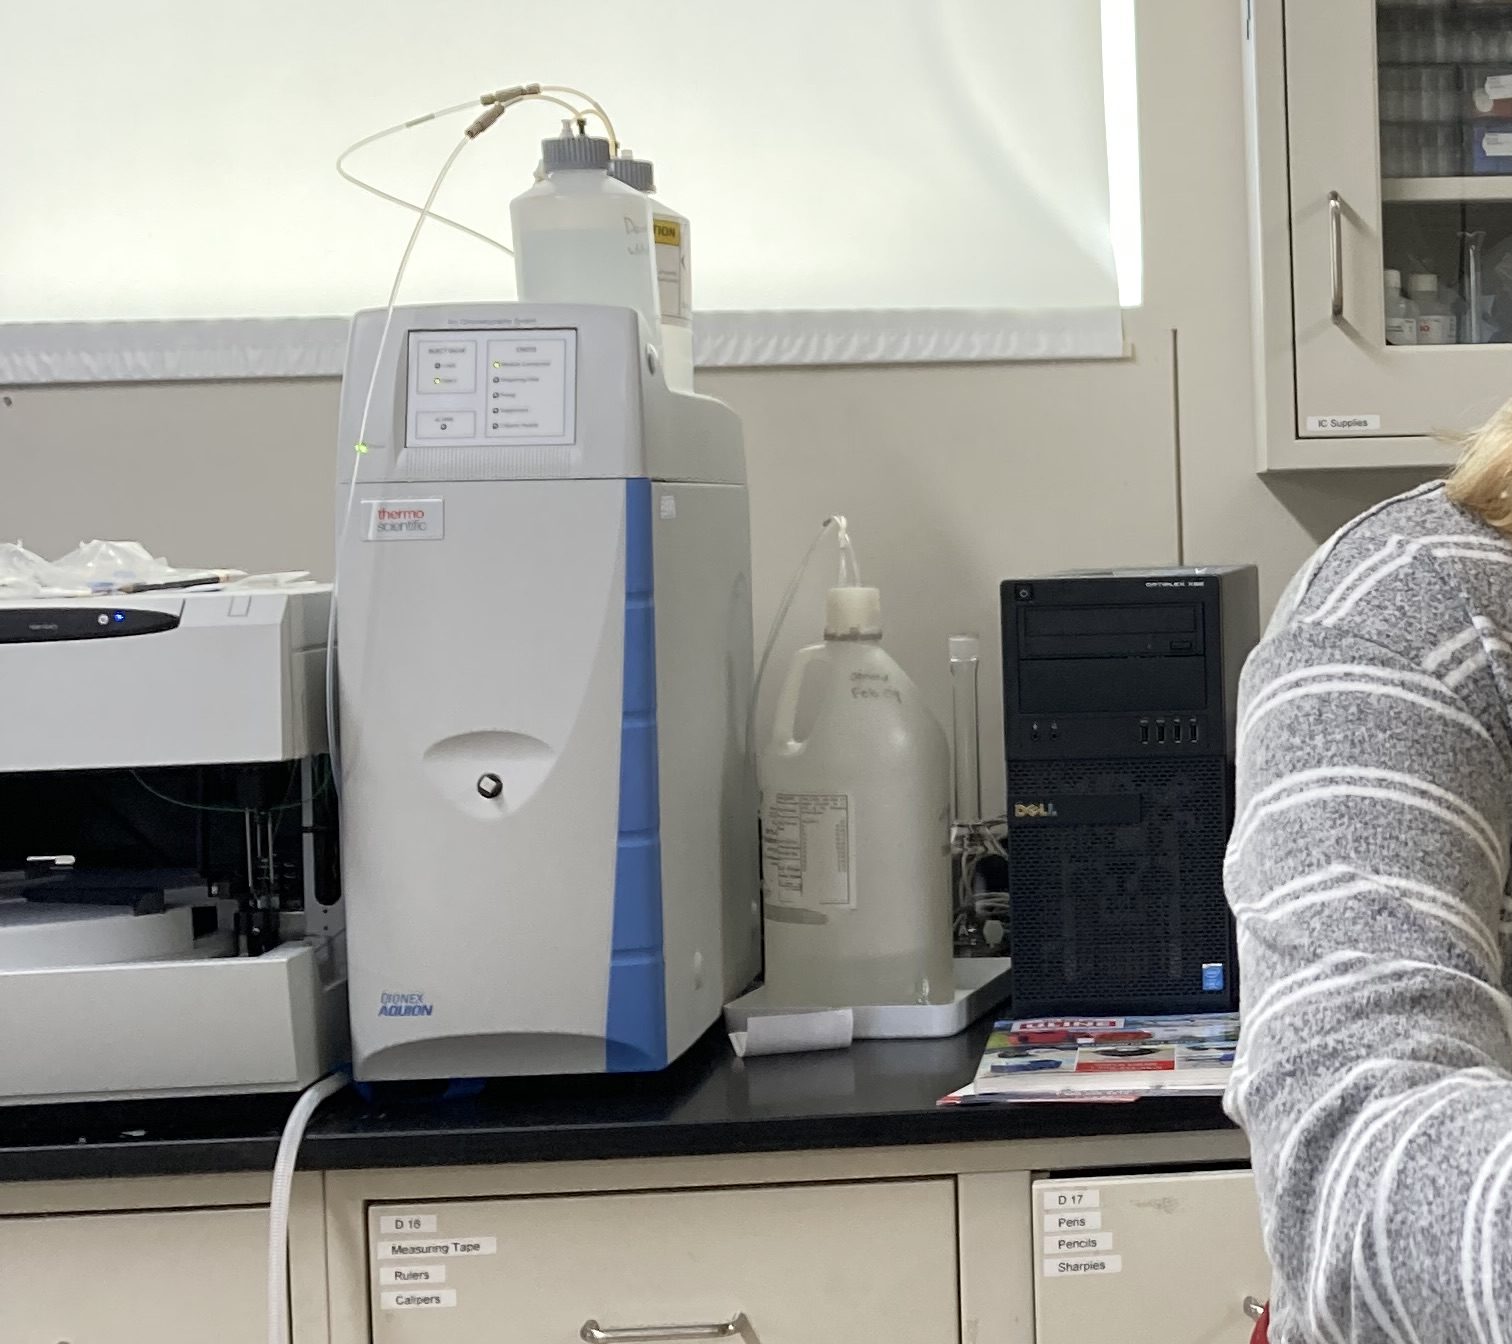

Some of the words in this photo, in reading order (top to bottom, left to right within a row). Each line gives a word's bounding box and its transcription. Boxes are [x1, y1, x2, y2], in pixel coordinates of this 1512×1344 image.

[1318, 419, 1328, 428] IC
[1330, 418, 1368, 428] Supplies
[377, 507, 425, 520] thermo
[377, 520, 427, 532] scientific
[1014, 803, 1057, 817] DELL
[380, 992, 424, 1004] DIONEX
[1058, 1195, 1067, 1205] D
[1071, 1194, 1083, 1205] 17
[394, 1219, 404, 1230] D
[1058, 1218, 1086, 1227] Pens
[391, 1243, 449, 1255] Measuring
[453, 1241, 480, 1253] Tape
[1058, 1238, 1097, 1249] Pencils
[1058, 1261, 1106, 1272] Sharpies
[394, 1270, 430, 1281] Rulers
[395, 1294, 441, 1306] Calipers
